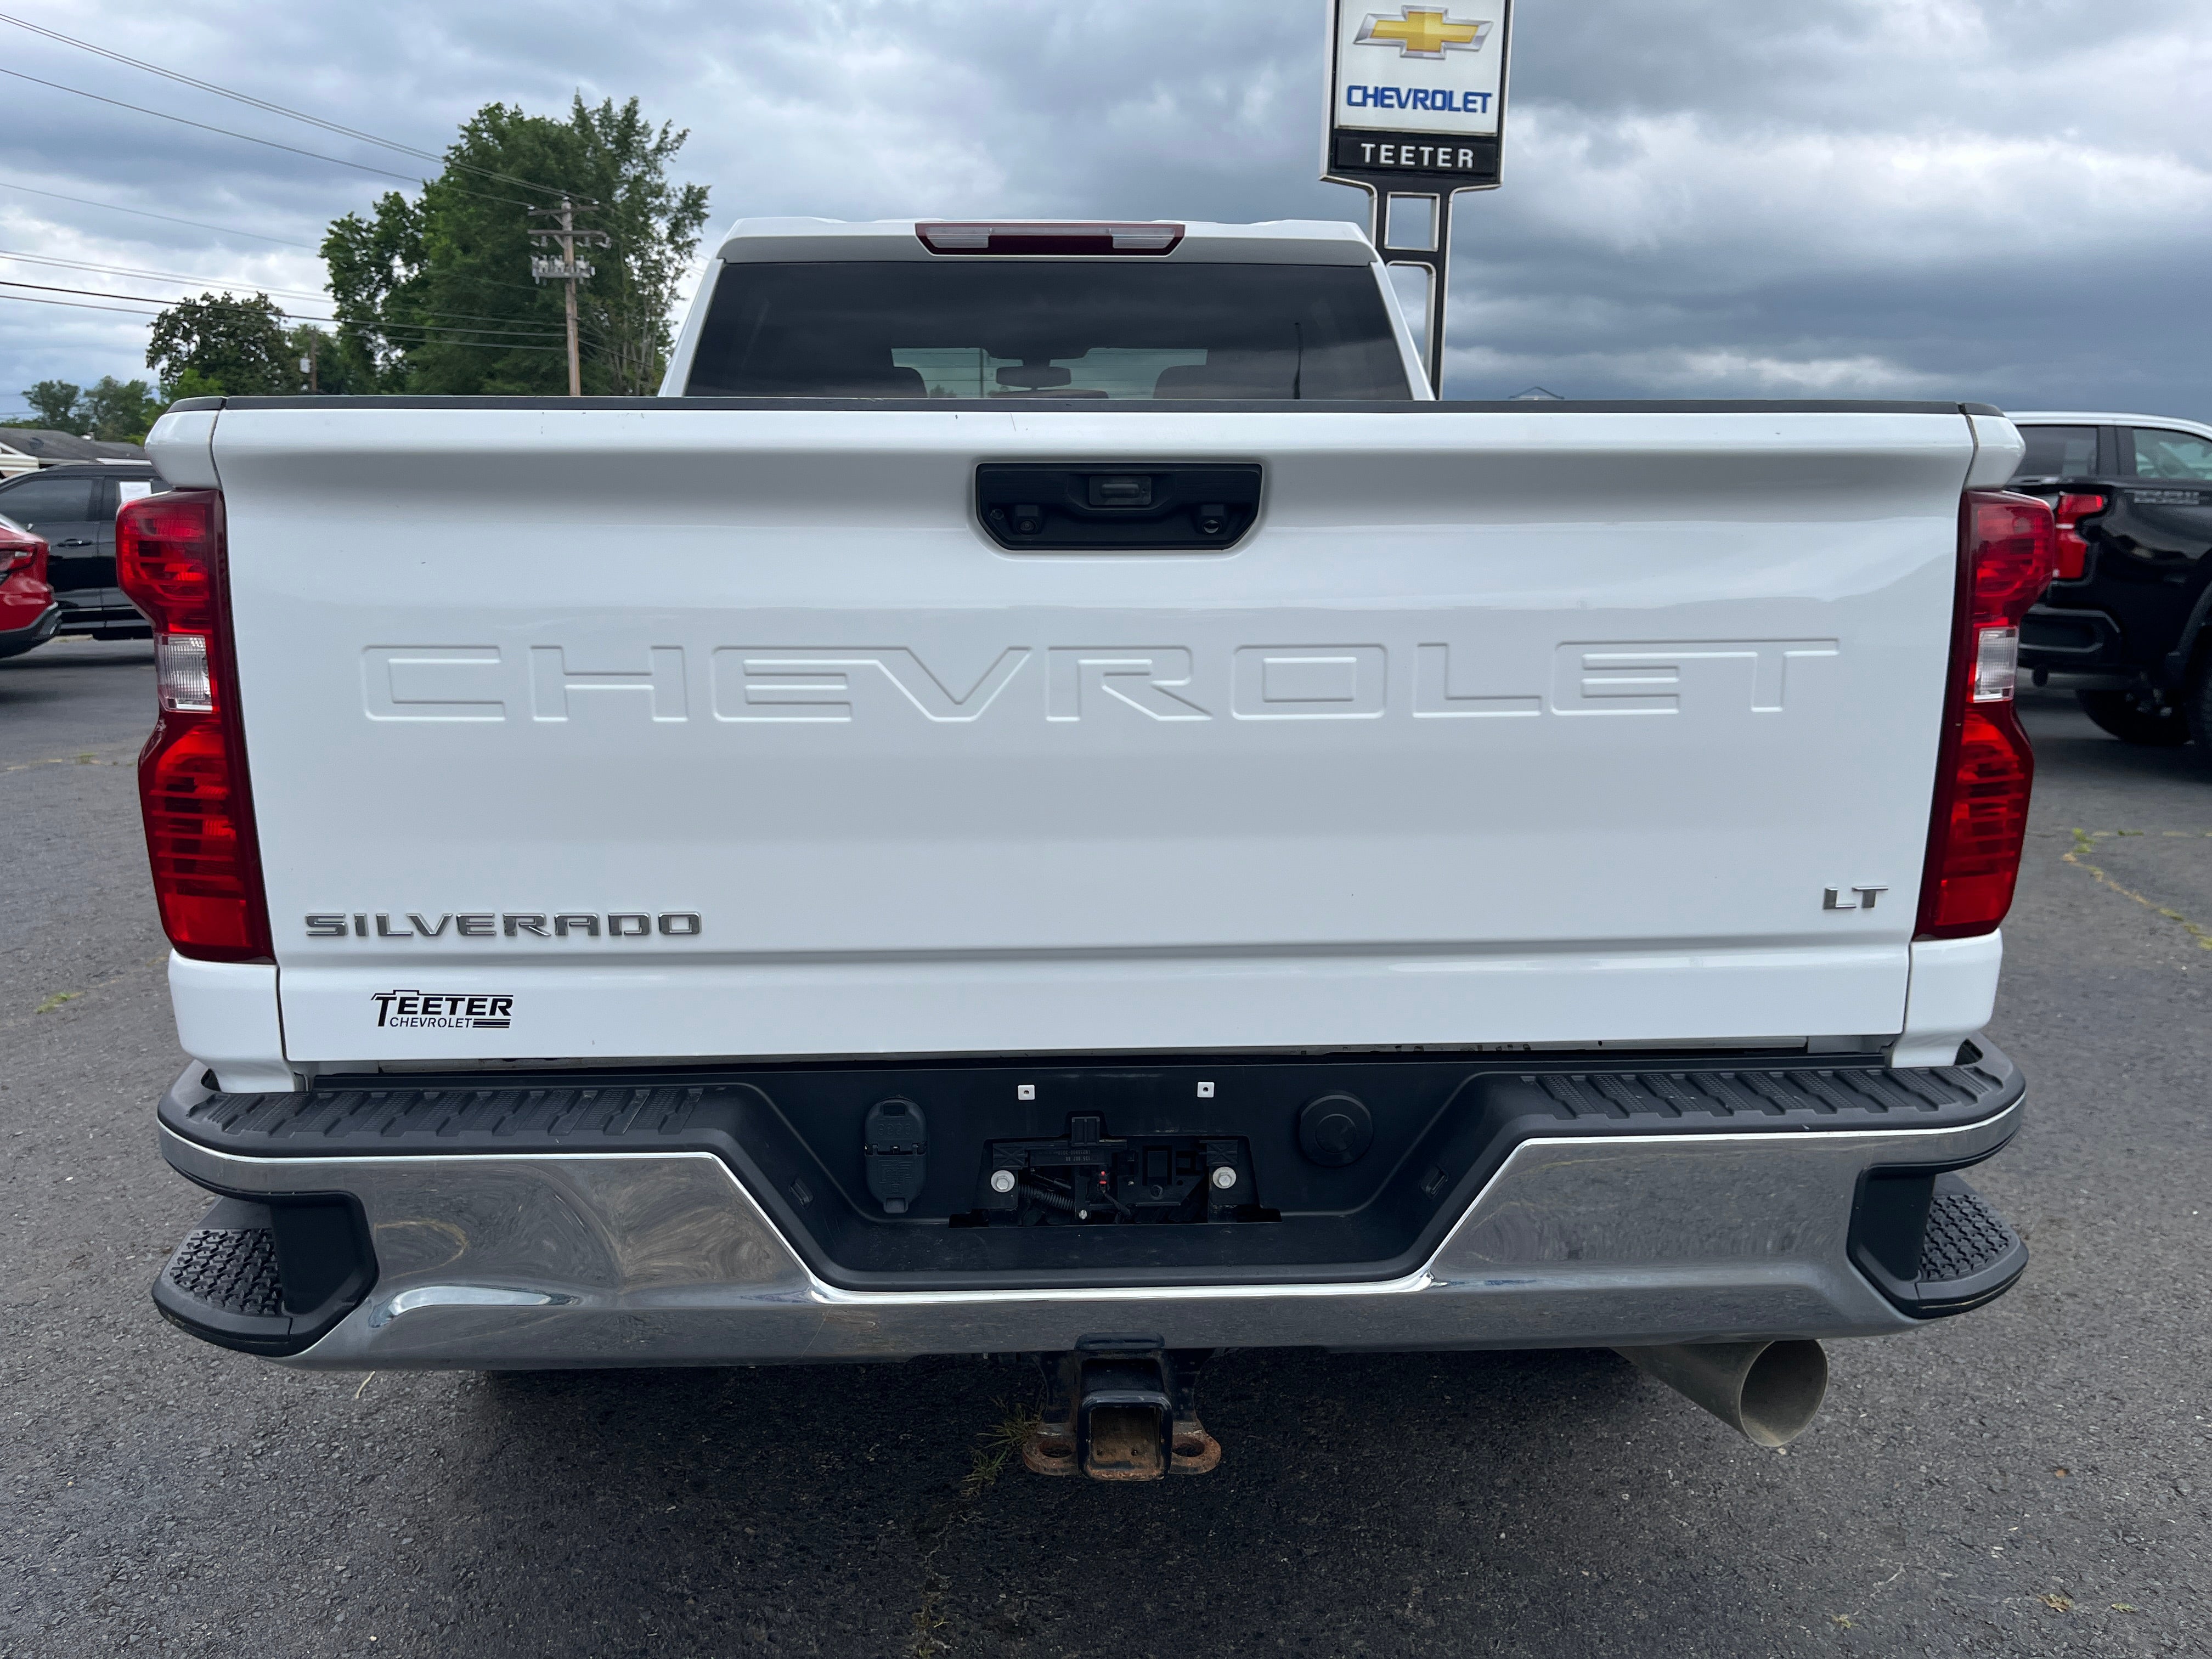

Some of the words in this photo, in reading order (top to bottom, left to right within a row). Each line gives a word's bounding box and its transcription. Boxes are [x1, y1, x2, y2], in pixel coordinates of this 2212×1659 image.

[1346, 84, 1493, 114] CHEVROLET
[1360, 143, 1474, 169] TEETER
[362, 637, 1839, 721] CHEVROLET
[1823, 885, 1889, 910] LT
[304, 911, 702, 938] SILVERADO
[375, 996, 513, 1027] TEETER
[390, 1017, 472, 1028] CHEVROLET
